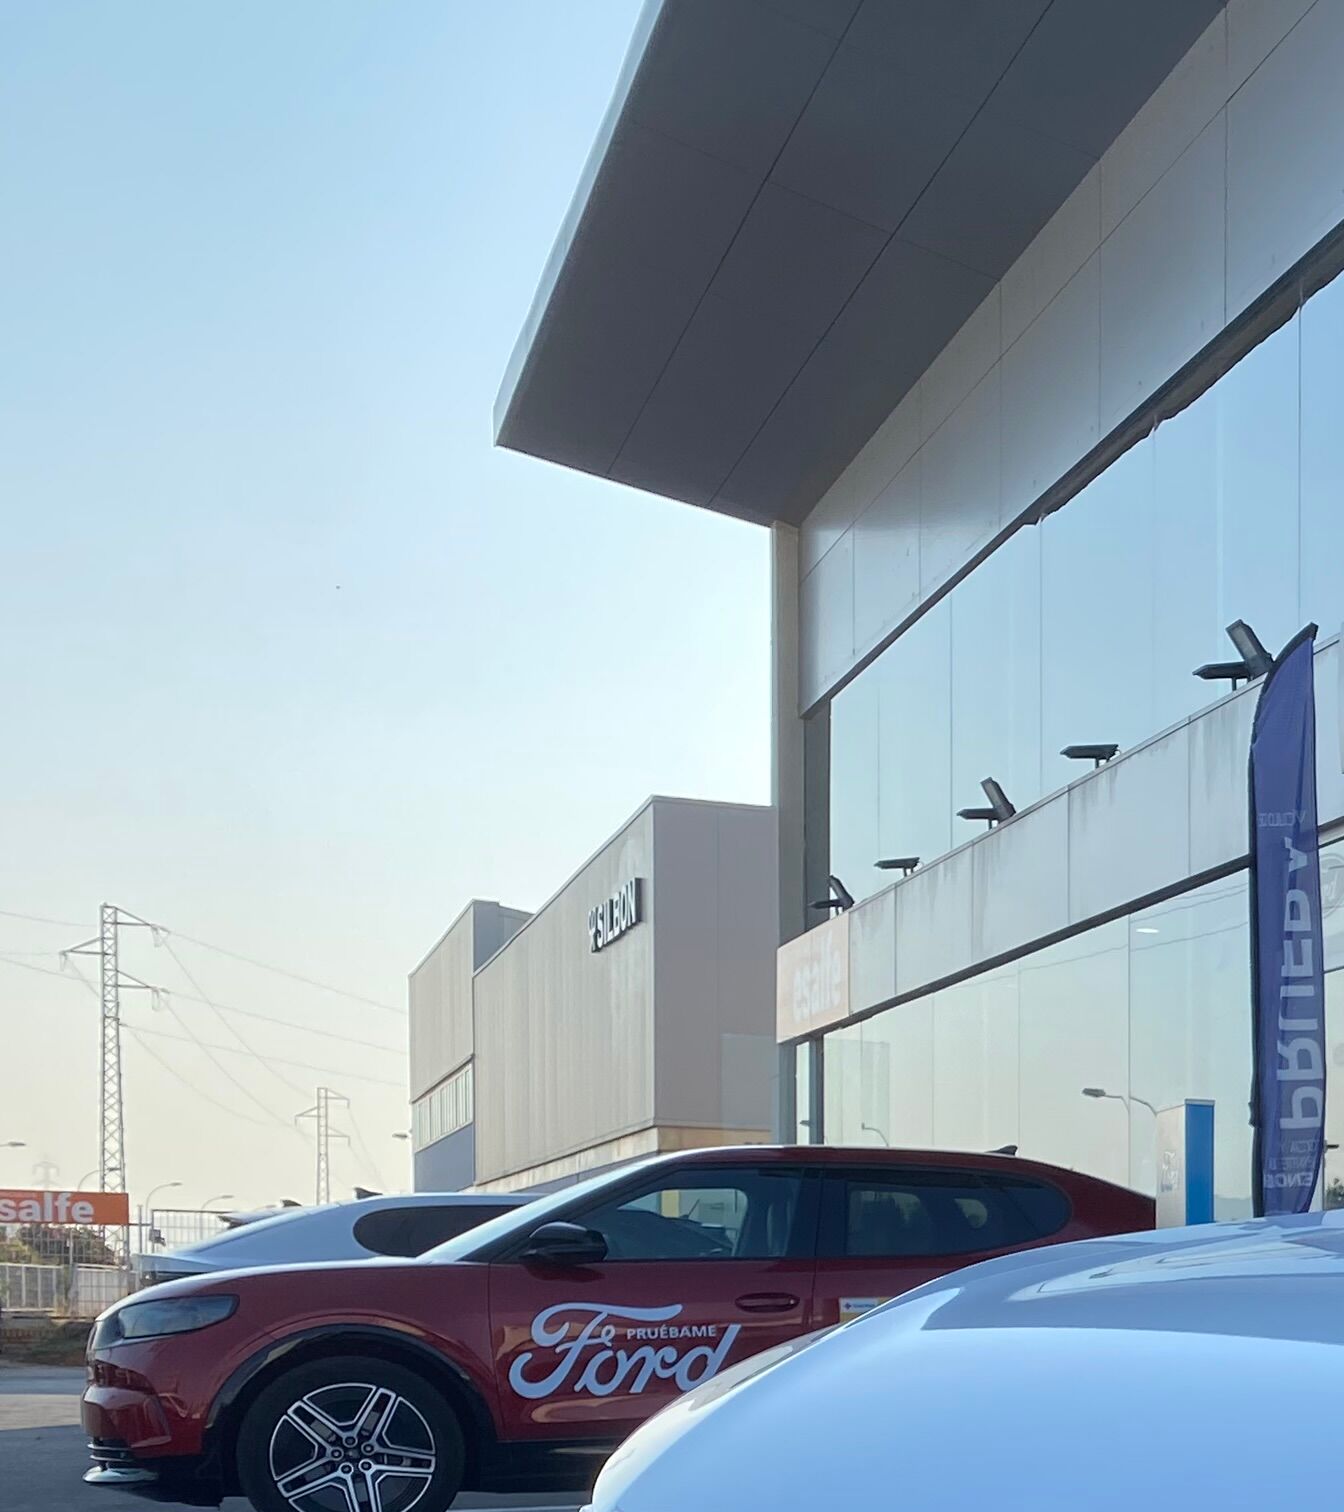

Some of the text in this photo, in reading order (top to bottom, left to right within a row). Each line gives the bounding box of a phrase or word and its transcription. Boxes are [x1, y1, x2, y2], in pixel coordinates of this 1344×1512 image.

[596, 877, 641, 951] SILBON
[0, 1192, 94, 1223] salfe
[508, 1302, 742, 1399] Ford
[626, 1323, 717, 1340] PRUÉBAME
